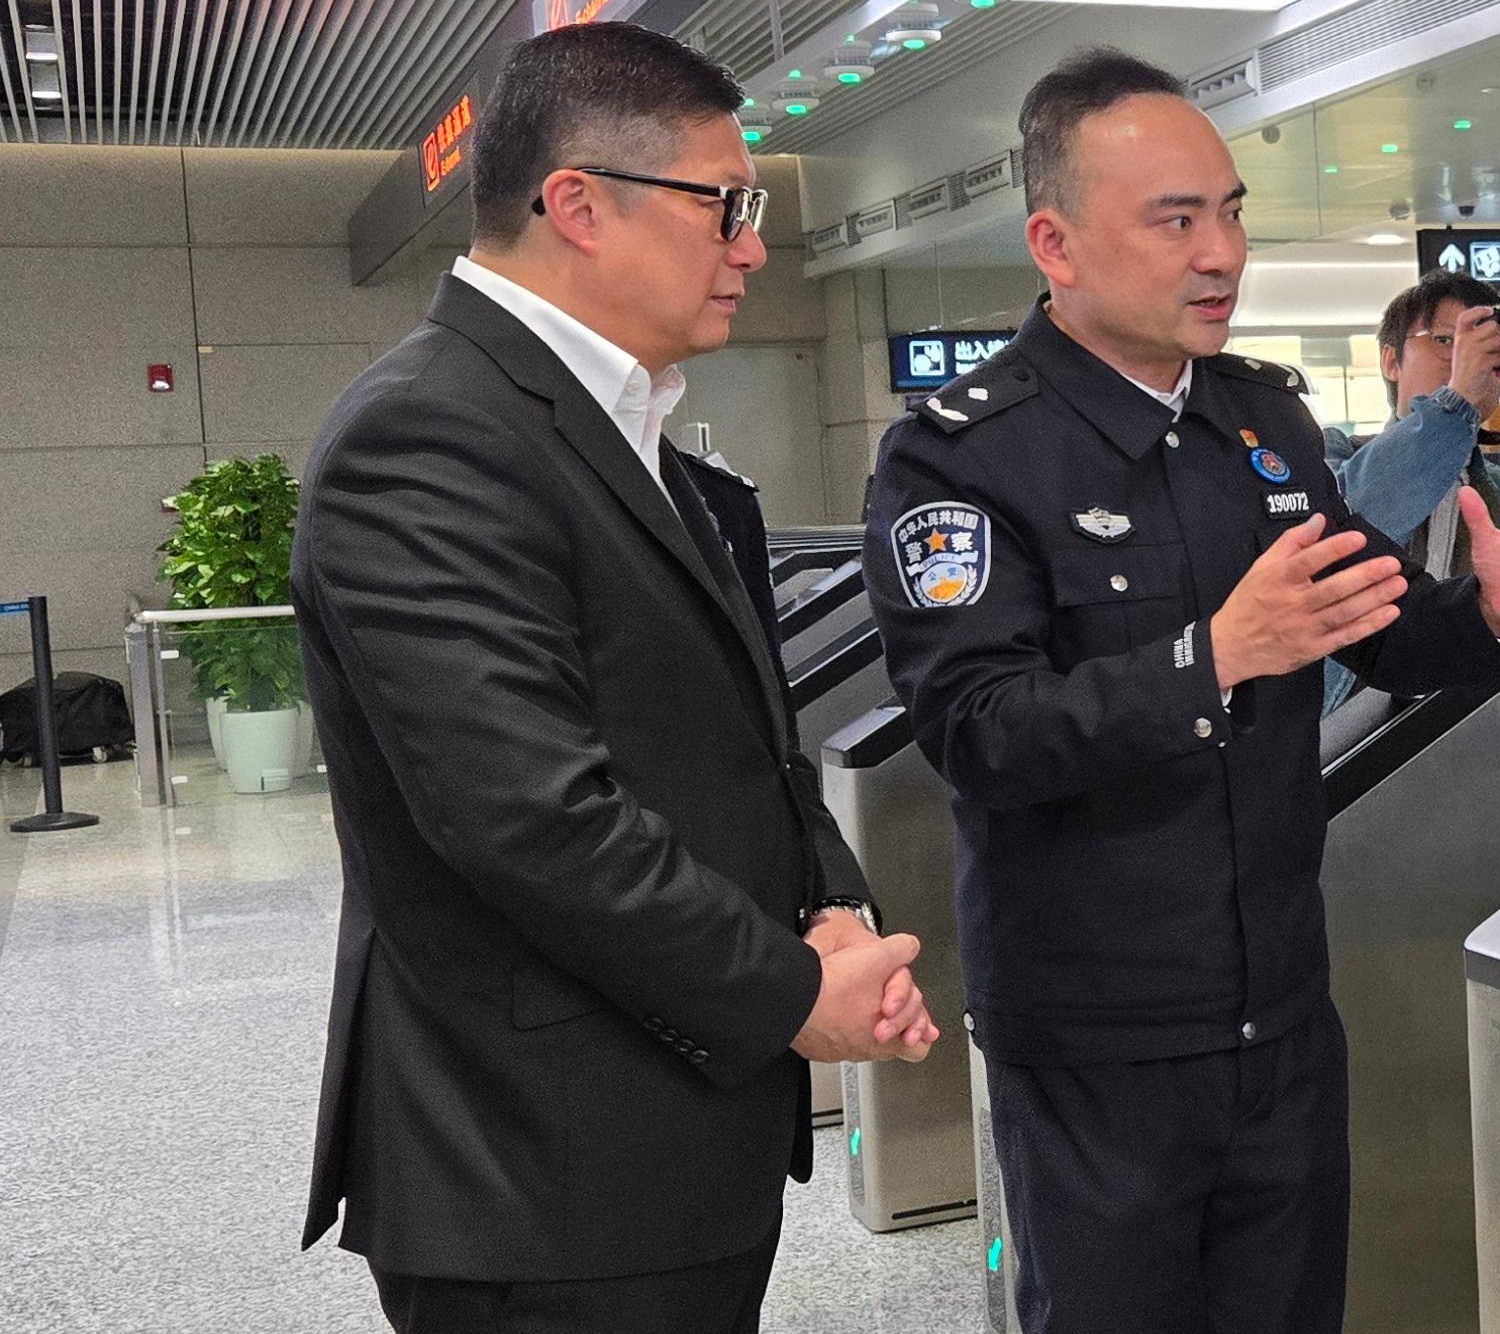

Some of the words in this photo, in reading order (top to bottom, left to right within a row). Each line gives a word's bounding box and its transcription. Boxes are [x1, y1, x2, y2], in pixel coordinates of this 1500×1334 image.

[1267, 492, 1309, 513] 190072
[898, 509, 979, 543] 中华人民共和国
[905, 542, 922, 564] 警
[951, 532, 973, 552] 察
[1173, 638, 1186, 668] CHINA
